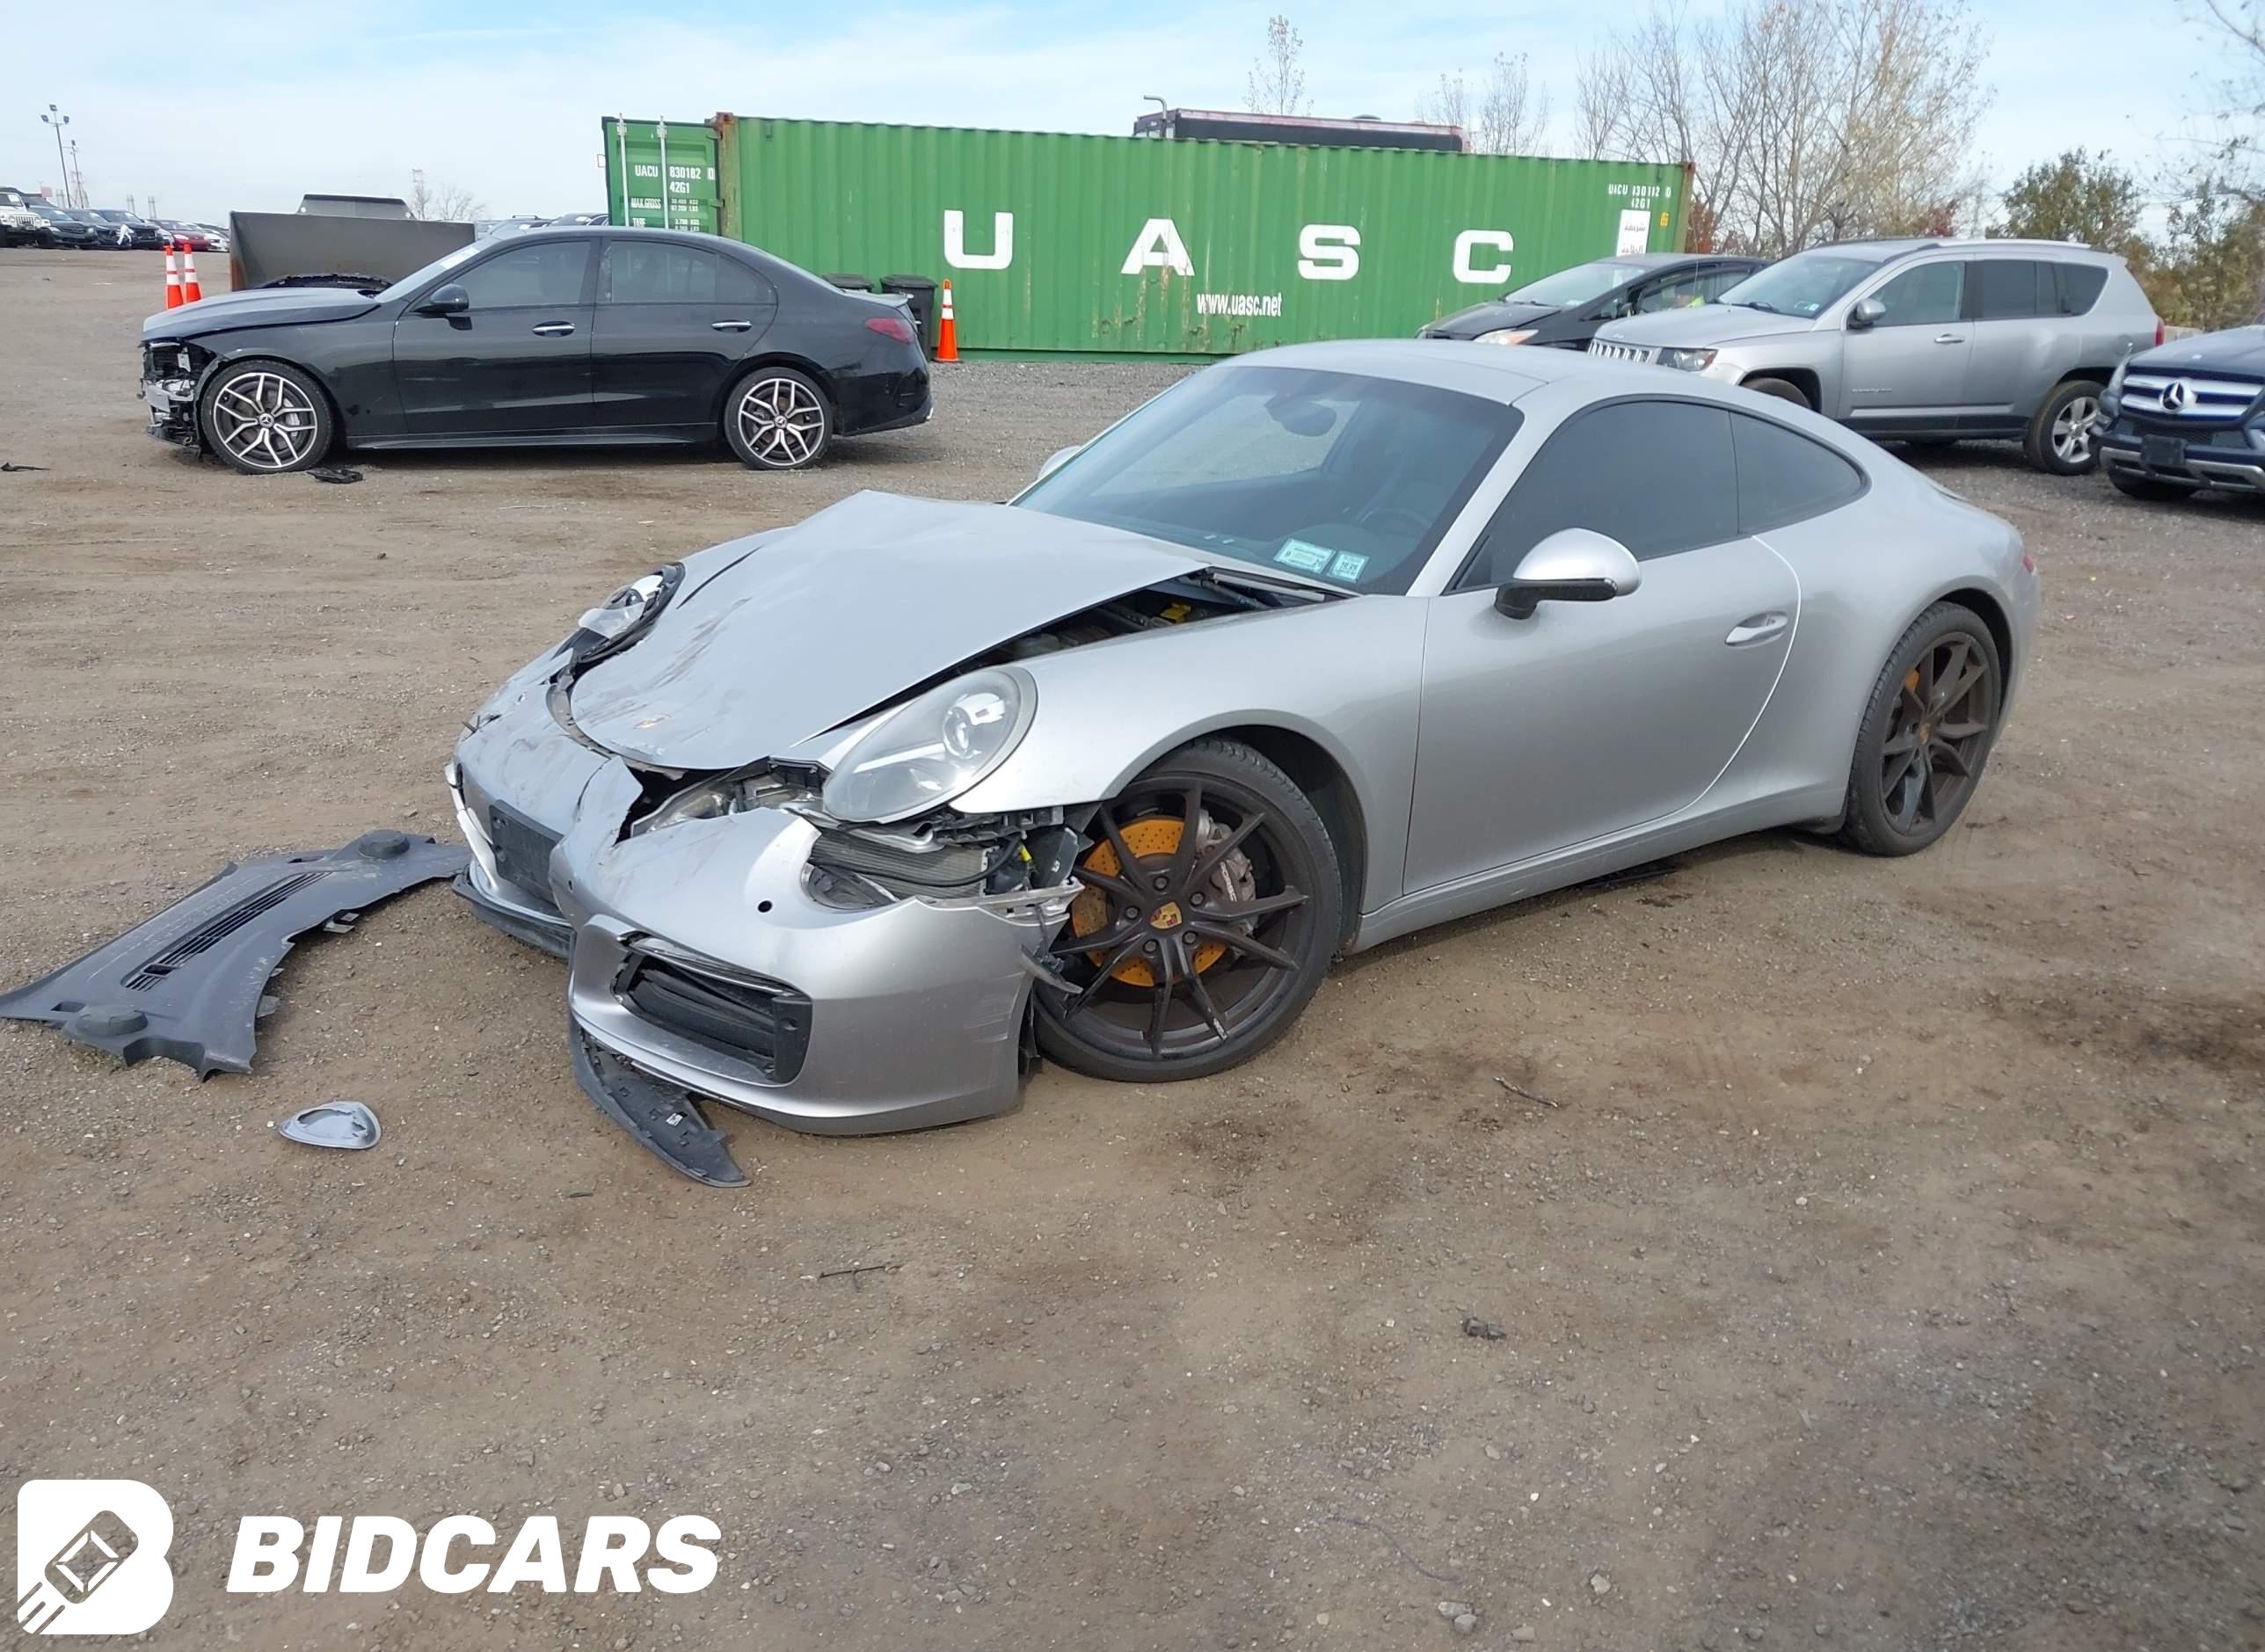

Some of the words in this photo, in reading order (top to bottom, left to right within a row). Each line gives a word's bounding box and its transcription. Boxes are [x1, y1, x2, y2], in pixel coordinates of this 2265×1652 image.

[635, 164, 659, 178] UACU
[669, 166, 702, 179] 830182
[669, 181, 690, 193] 42G1
[1197, 292, 1282, 317] www.uasc.net
